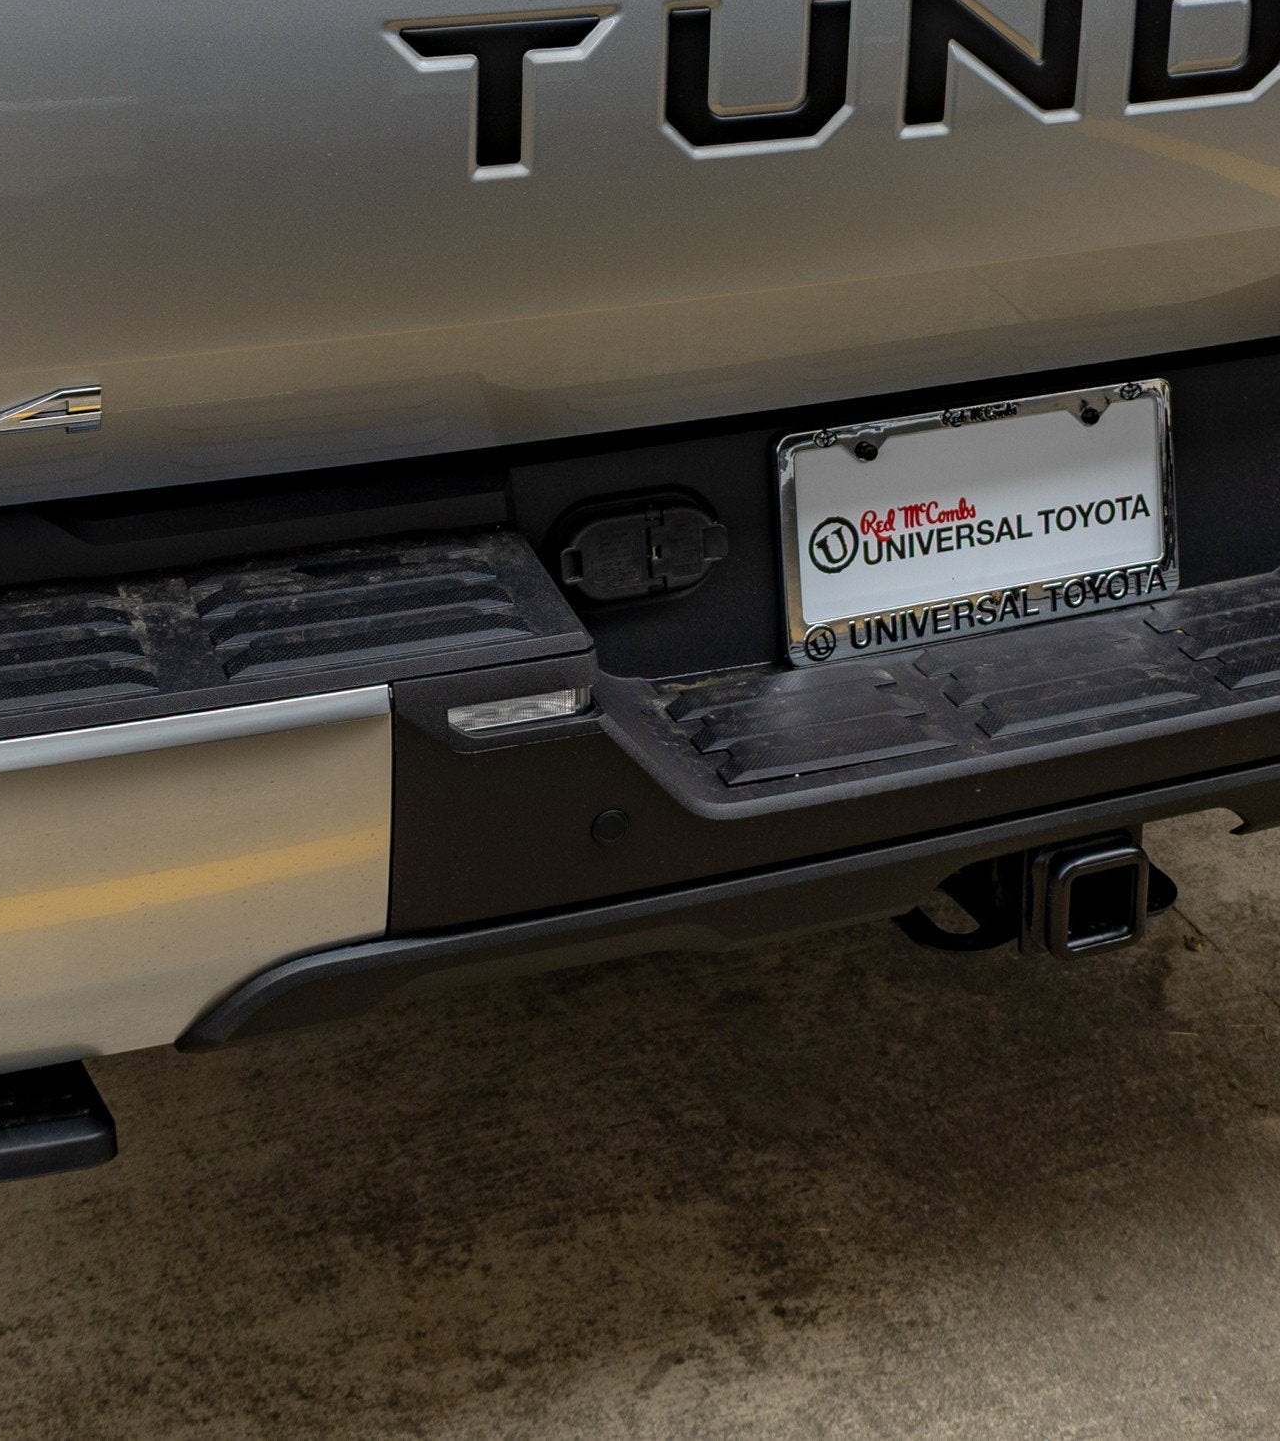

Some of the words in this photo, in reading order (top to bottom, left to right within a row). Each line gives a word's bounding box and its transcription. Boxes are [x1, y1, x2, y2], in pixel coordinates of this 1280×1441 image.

[860, 508, 896, 542] Red
[898, 497, 977, 529] McCombs
[862, 514, 1033, 566] UNIVERSAL
[1037, 493, 1151, 535] TOYOTA
[848, 588, 1040, 650] UNIVERSAL
[1042, 564, 1168, 612] TOYOTA
